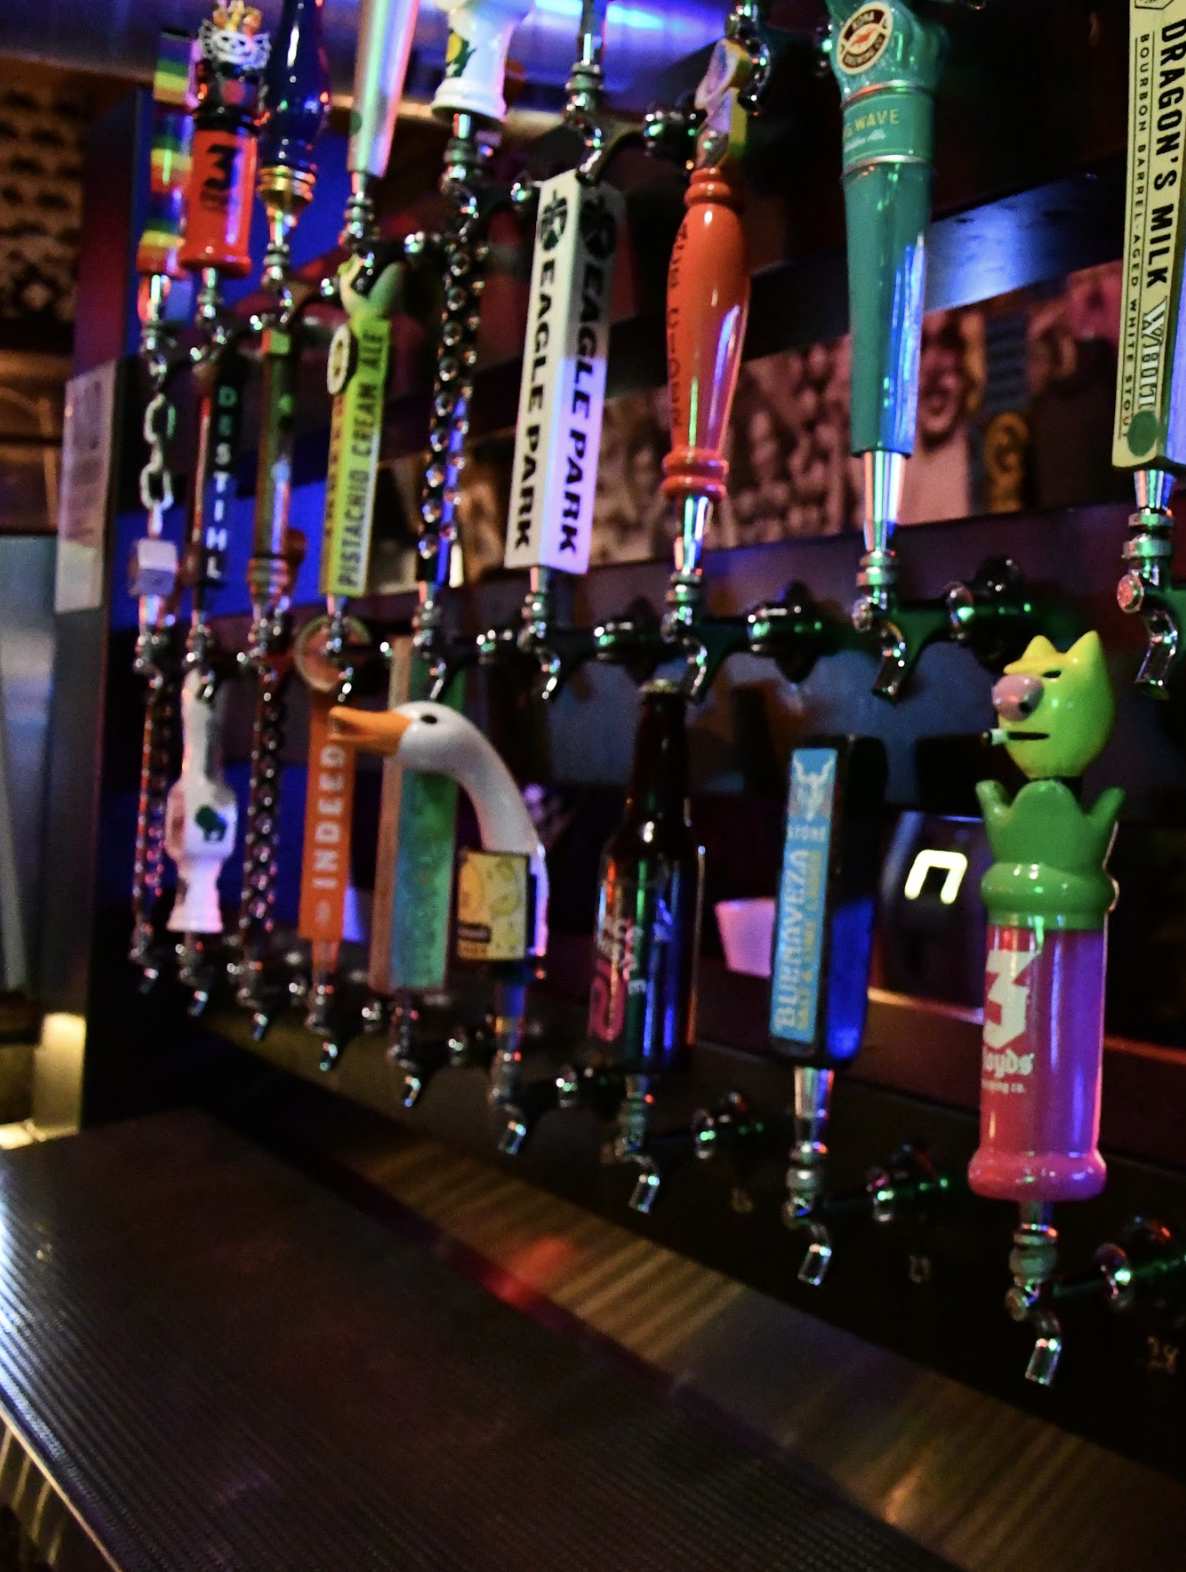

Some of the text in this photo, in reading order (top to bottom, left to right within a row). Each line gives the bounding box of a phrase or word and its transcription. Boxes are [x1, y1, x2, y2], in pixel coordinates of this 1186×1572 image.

[854, 107, 901, 132] WAVE
[1137, 32, 1151, 132] BOURBON
[1146, 202, 1175, 289] MILK
[1125, 298, 1138, 362] WHITE
[1138, 295, 1169, 411] WHIT
[350, 382, 379, 457] CREAM
[513, 258, 556, 552] EAGLE PARK
[557, 264, 602, 555] EAGLE PARK
[337, 470, 372, 589] PISTACHIO
[311, 744, 347, 890] INDEED
[983, 948, 1043, 1050] 3
